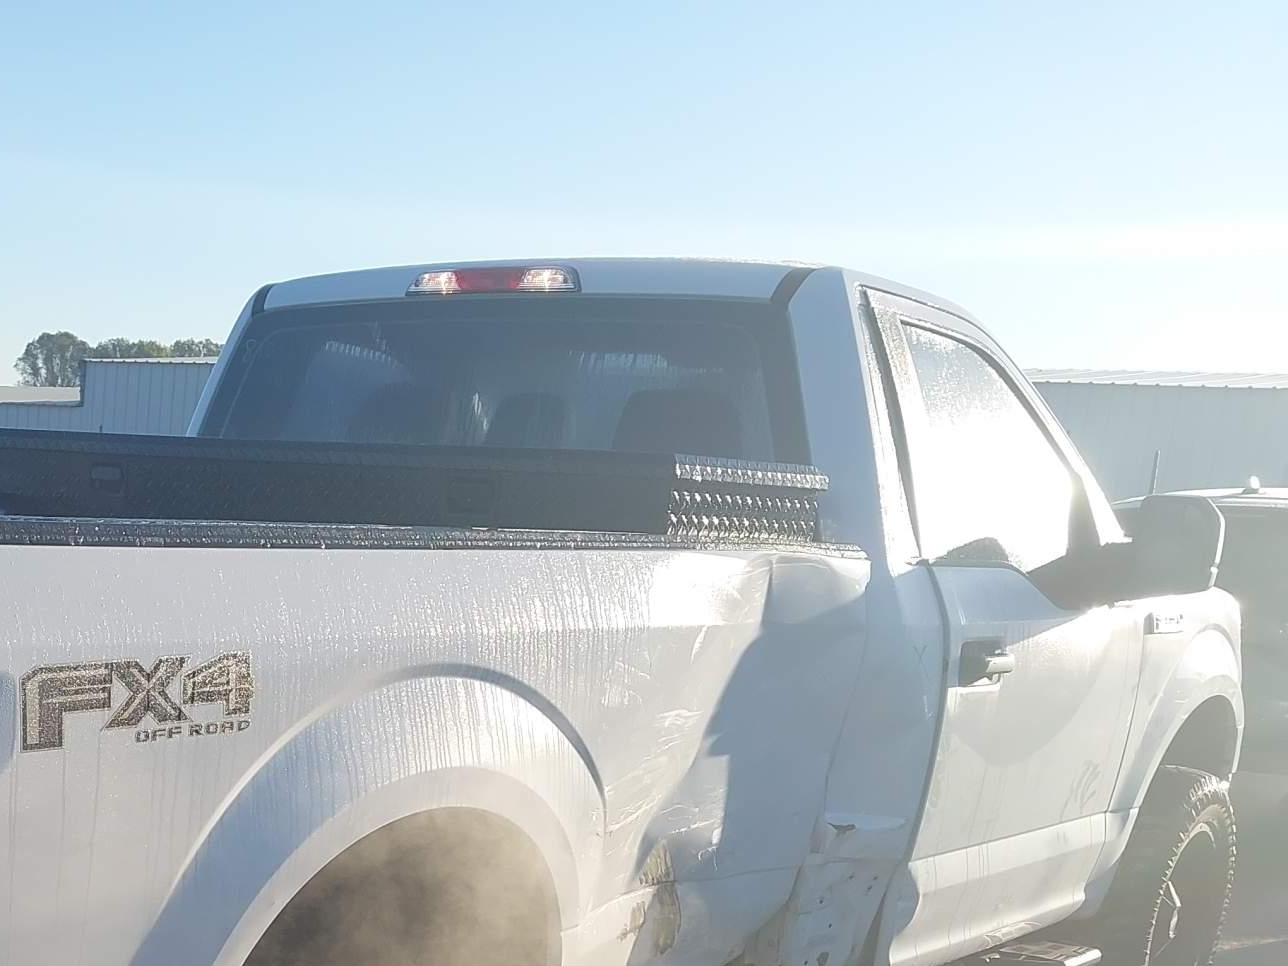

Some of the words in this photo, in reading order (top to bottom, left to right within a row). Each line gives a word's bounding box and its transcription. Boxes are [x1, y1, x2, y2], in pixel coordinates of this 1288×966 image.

[18, 650, 255, 754] FX4
[134, 726, 183, 744] OFF
[188, 719, 251, 737] ROAD
